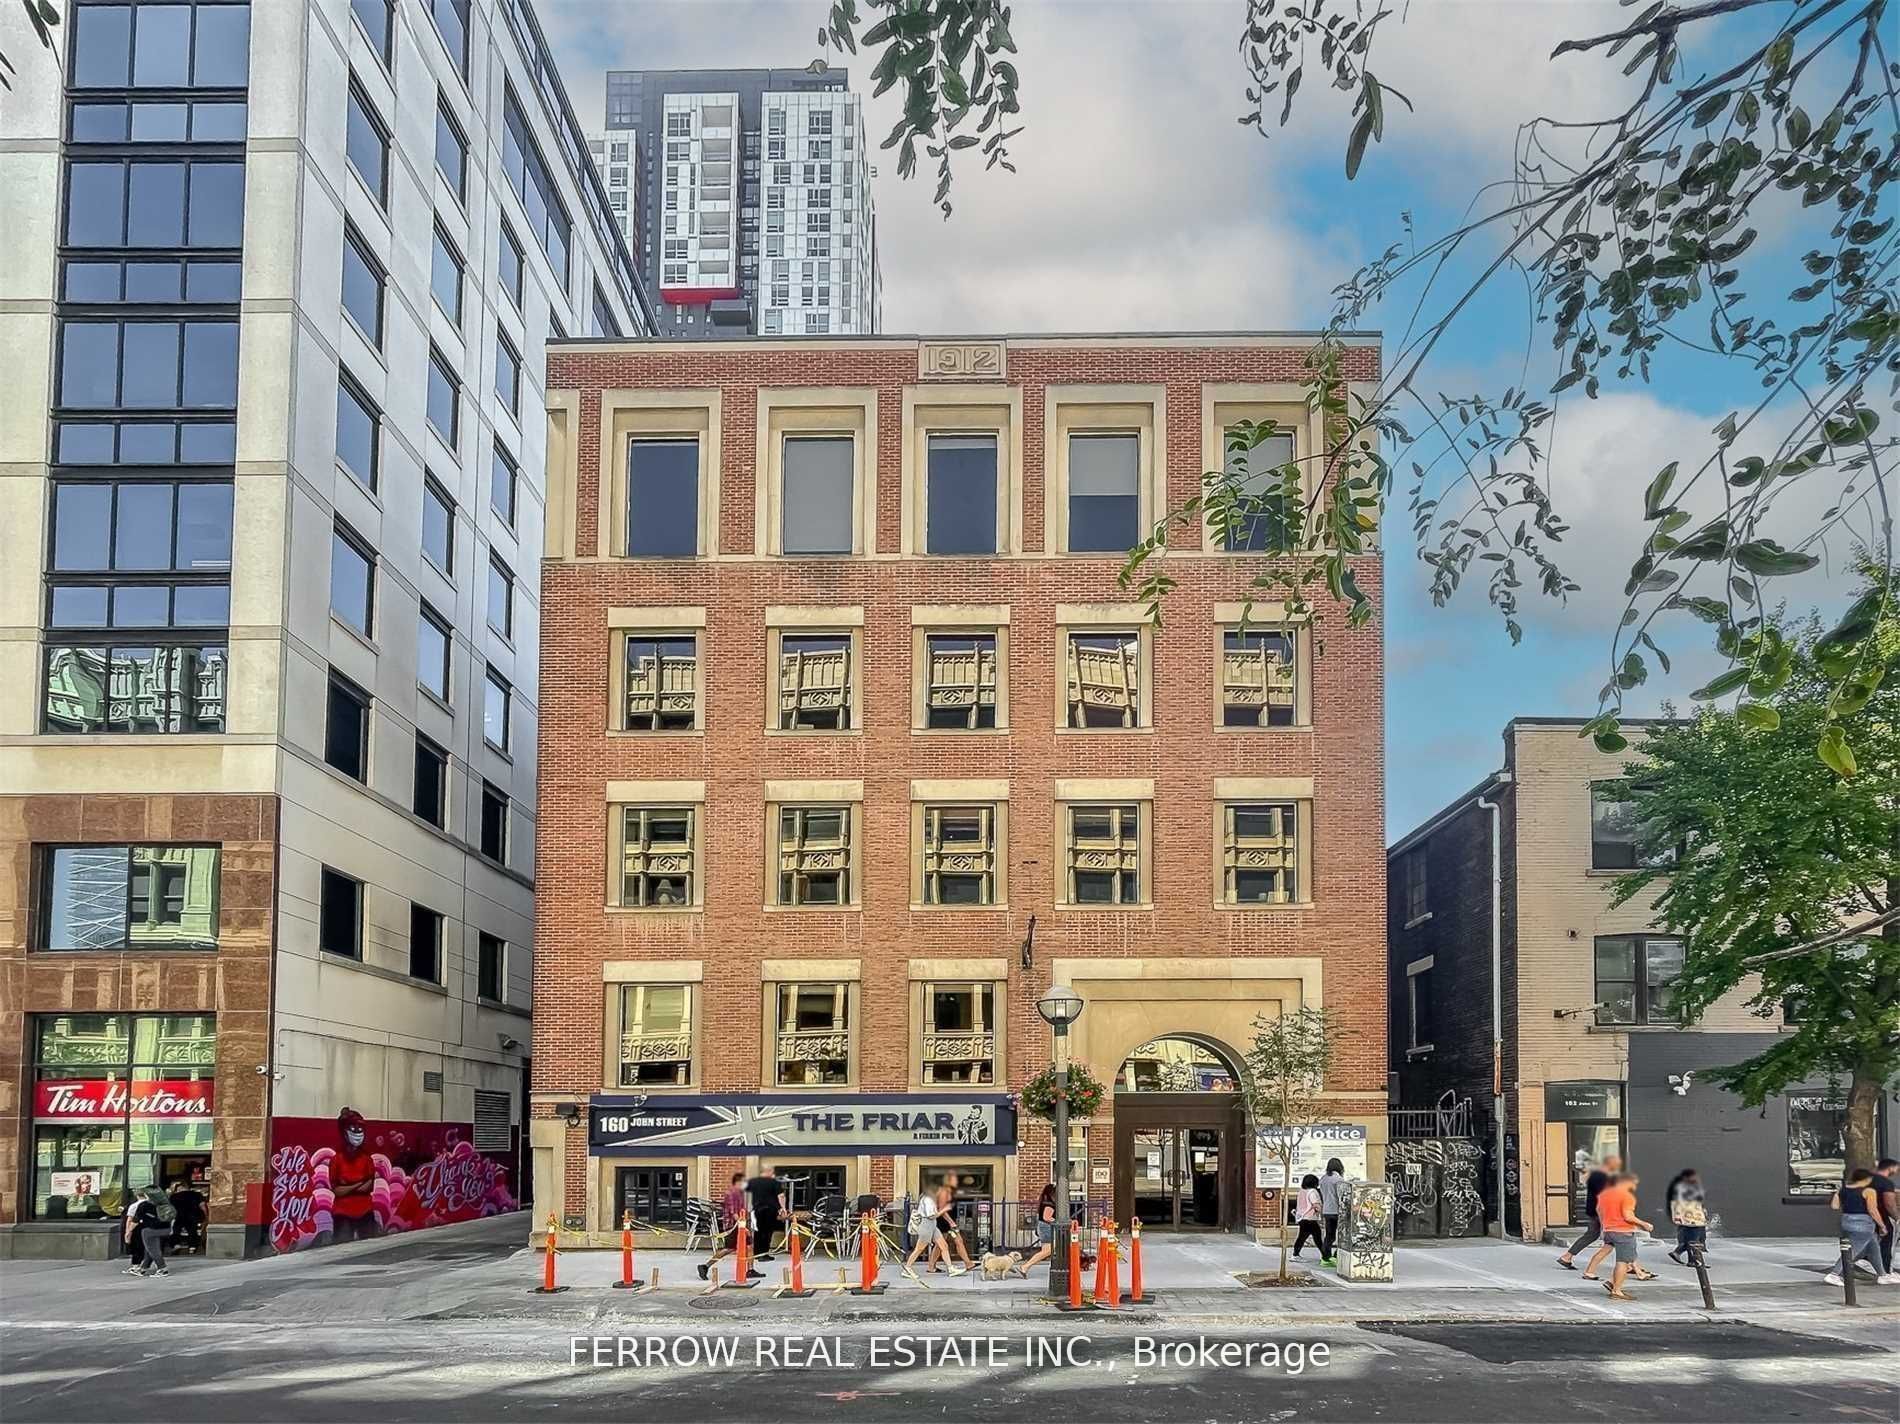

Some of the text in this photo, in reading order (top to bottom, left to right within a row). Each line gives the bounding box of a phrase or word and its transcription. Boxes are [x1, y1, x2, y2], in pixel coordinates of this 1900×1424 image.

[927, 346, 998, 371] 1912
[47, 1085, 97, 1113] Tim
[600, 1116, 688, 1133] 160 JOHN STREET
[791, 1112, 955, 1132] THE FRIAR
[1292, 1126, 1361, 1140] Notice
